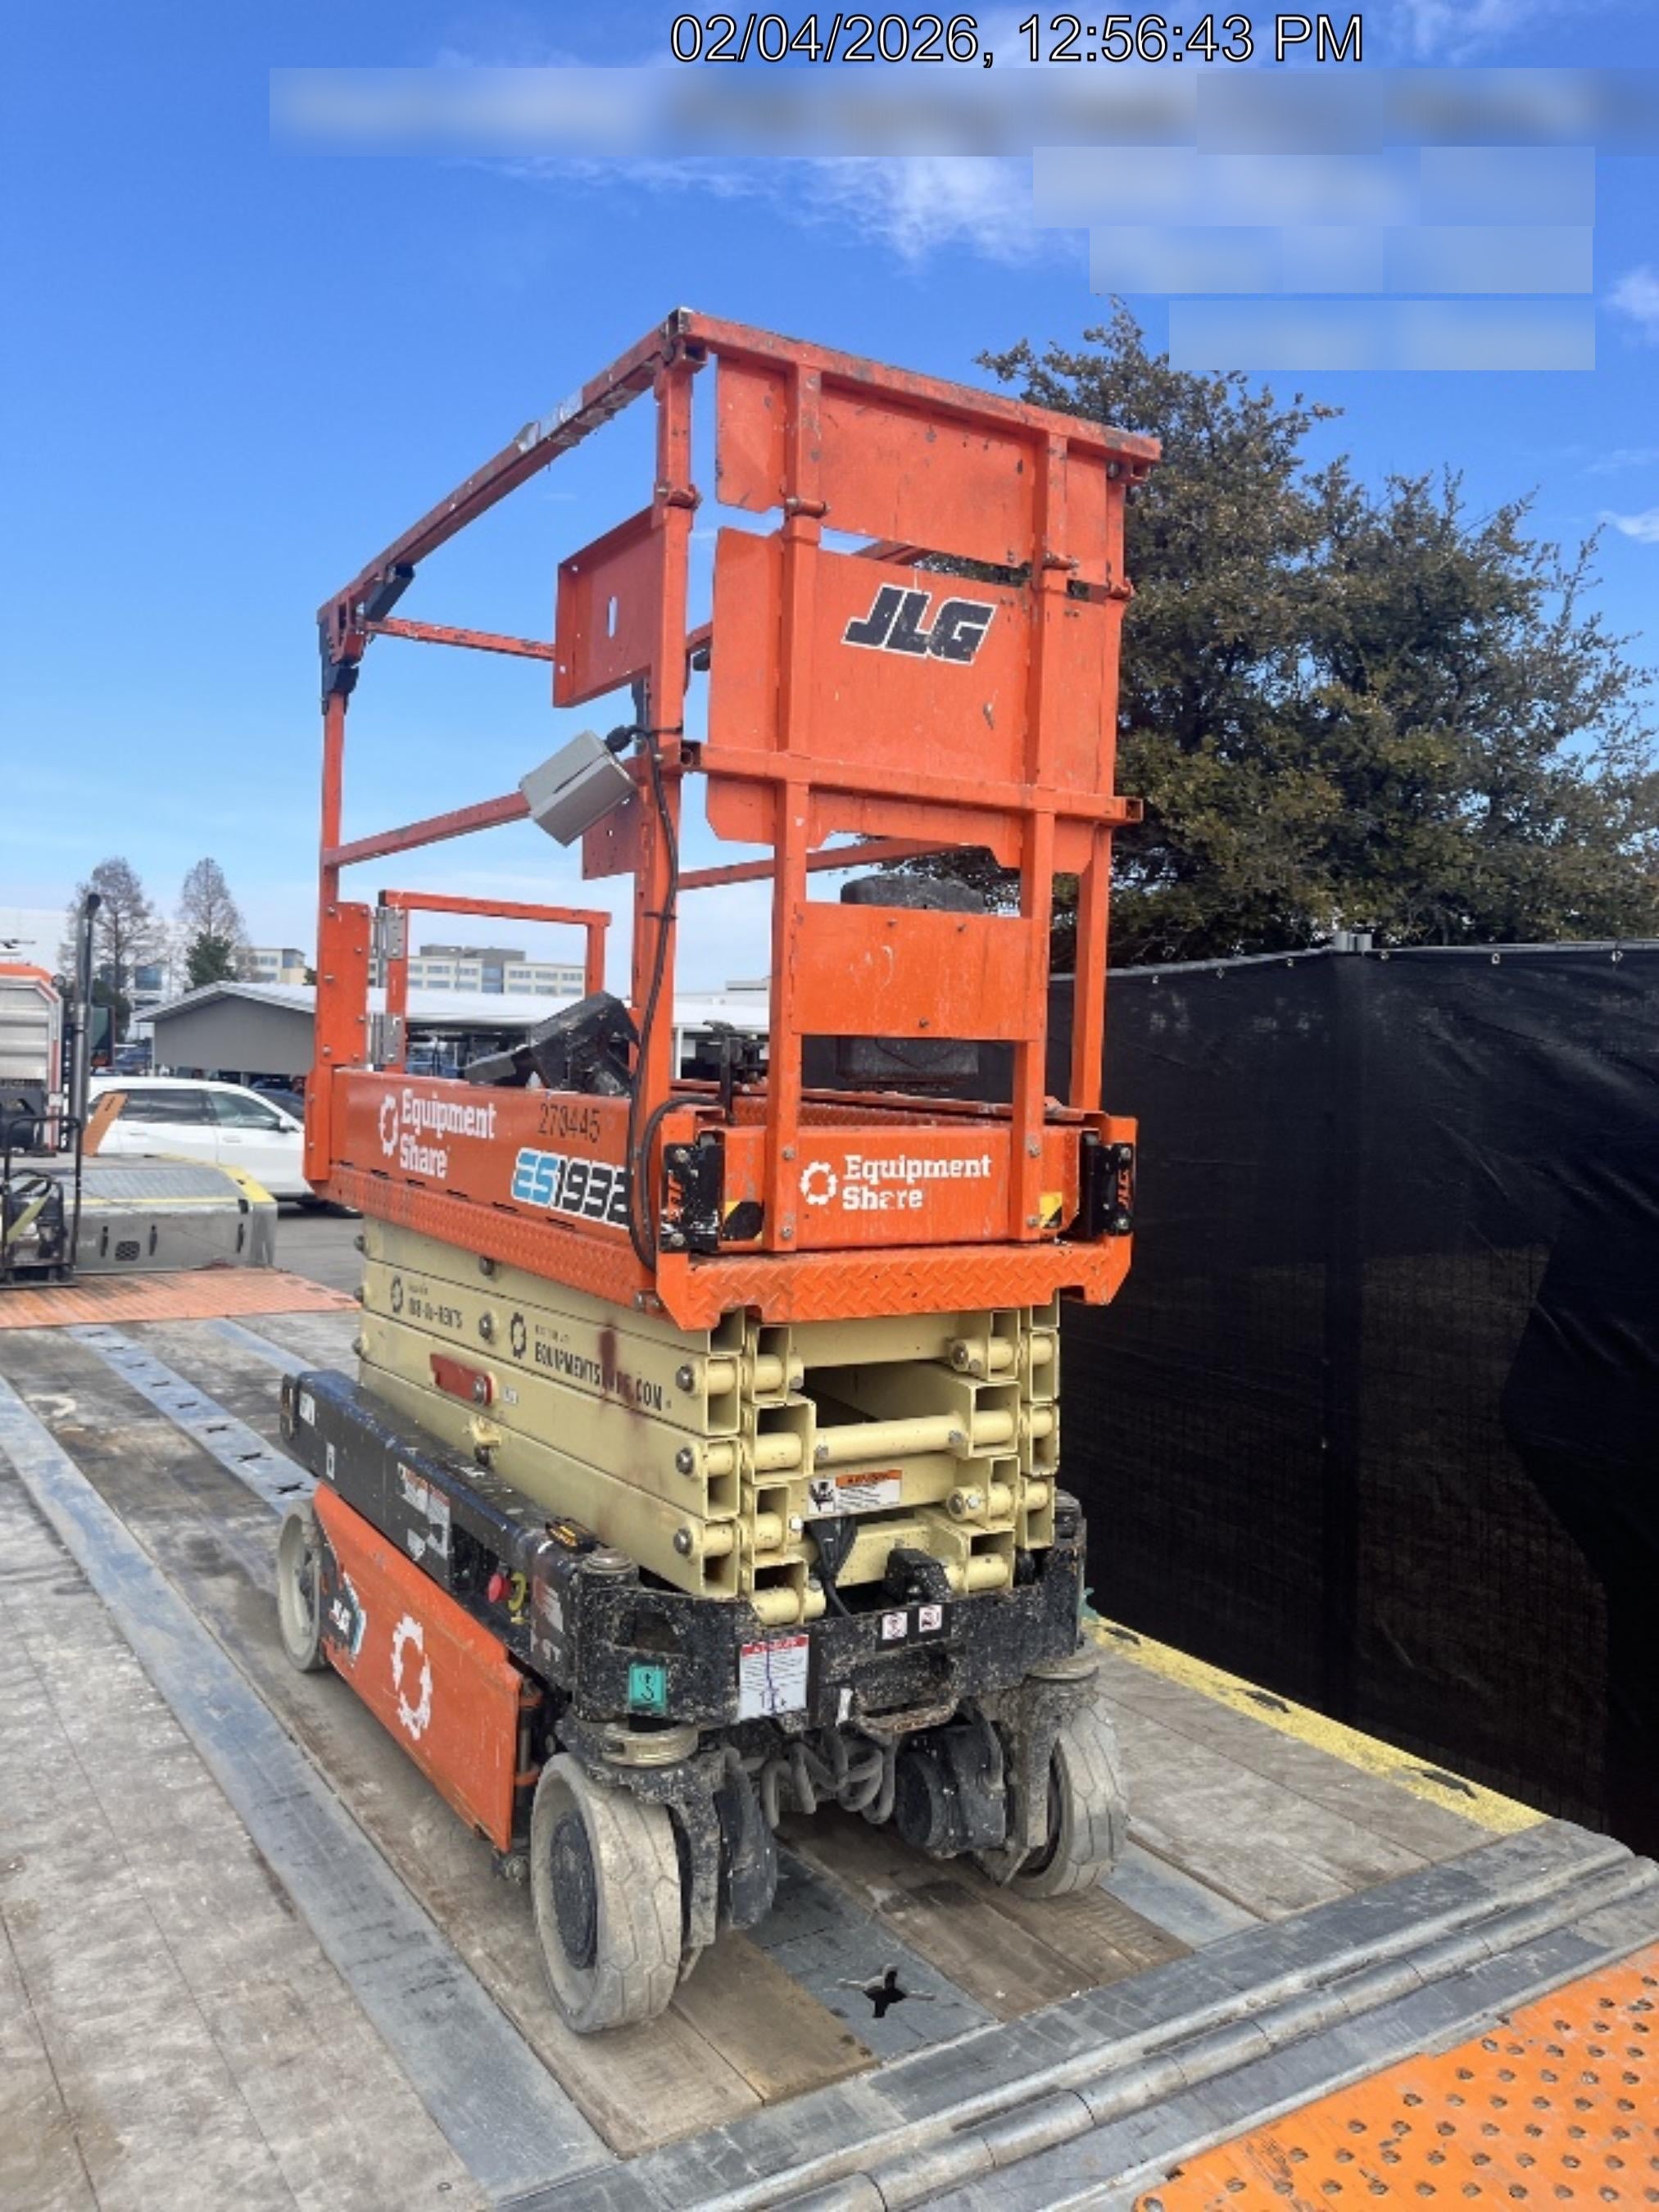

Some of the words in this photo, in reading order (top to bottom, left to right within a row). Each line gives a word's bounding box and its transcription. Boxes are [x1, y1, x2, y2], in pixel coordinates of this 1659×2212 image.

[841, 583, 998, 666] JLG
[401, 1088, 496, 1139] Equipment
[400, 1132, 447, 1179] Share
[843, 1154, 992, 1185] Equipment
[535, 1341, 663, 1412] EQUIPMENTSRE.COM
